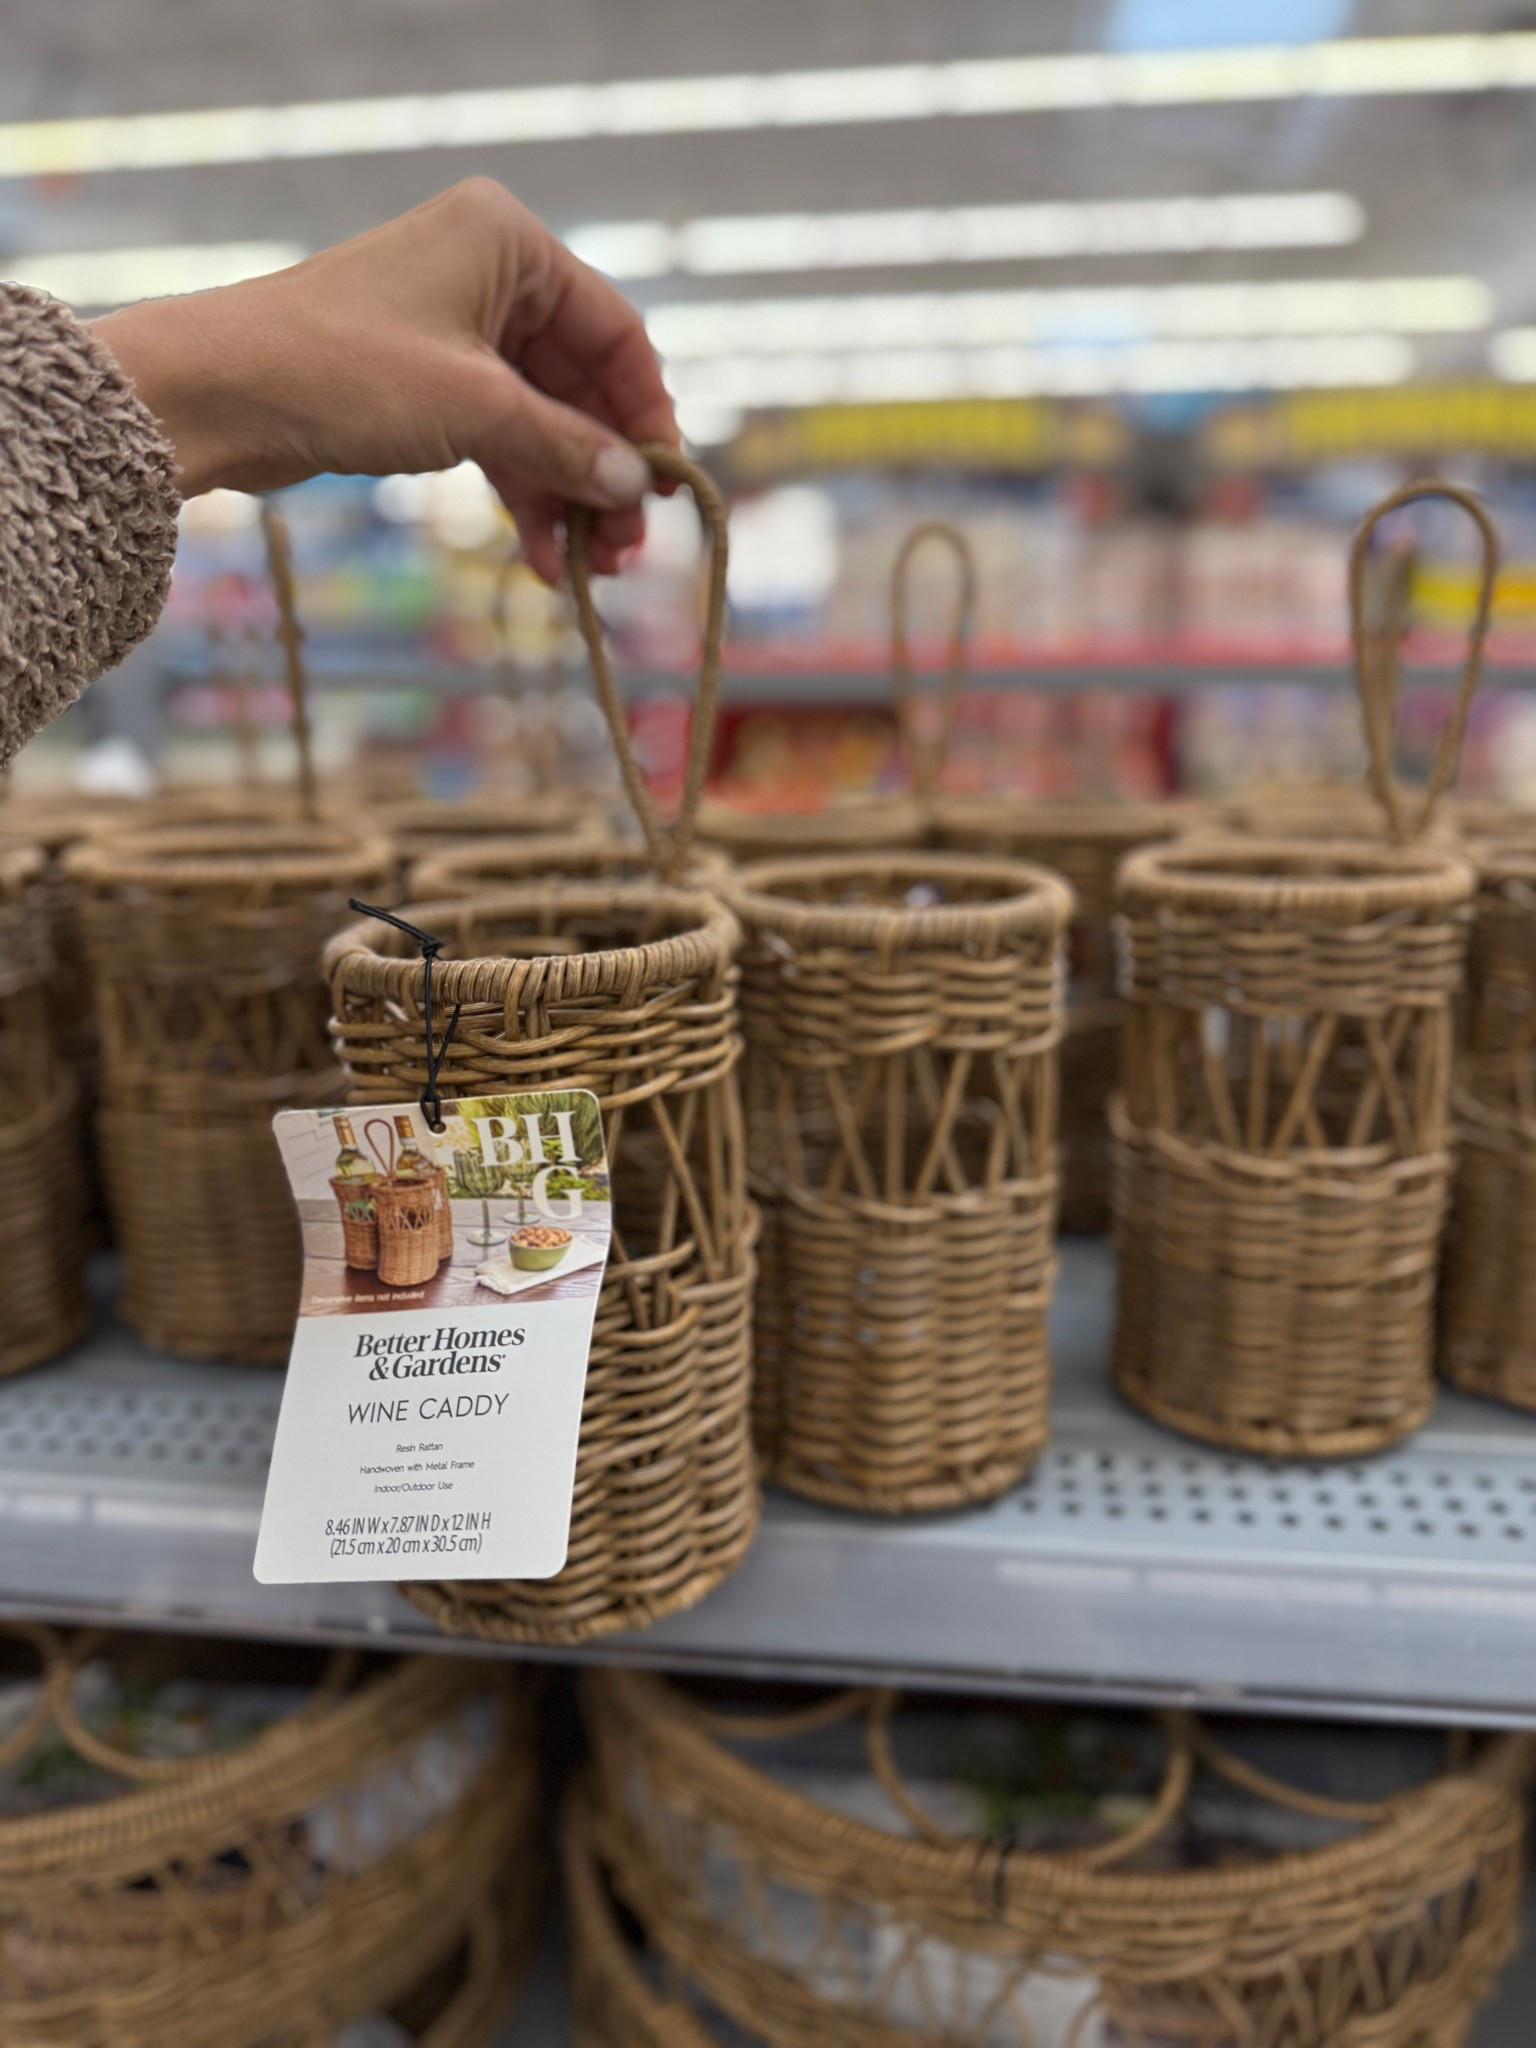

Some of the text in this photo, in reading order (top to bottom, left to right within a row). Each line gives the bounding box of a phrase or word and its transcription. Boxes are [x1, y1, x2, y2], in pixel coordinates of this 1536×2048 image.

[471, 1110, 583, 1167] BH
[532, 1165, 585, 1220] G
[353, 1326, 526, 1358] Better Homes
[368, 1356, 389, 1381] &
[348, 1392, 510, 1425] WINE CADDY
[396, 1442, 443, 1453] Resin Rattan
[359, 1460, 475, 1474] Handwoven with Metal Frame
[374, 1481, 454, 1494] Indoor/Outdoor Use
